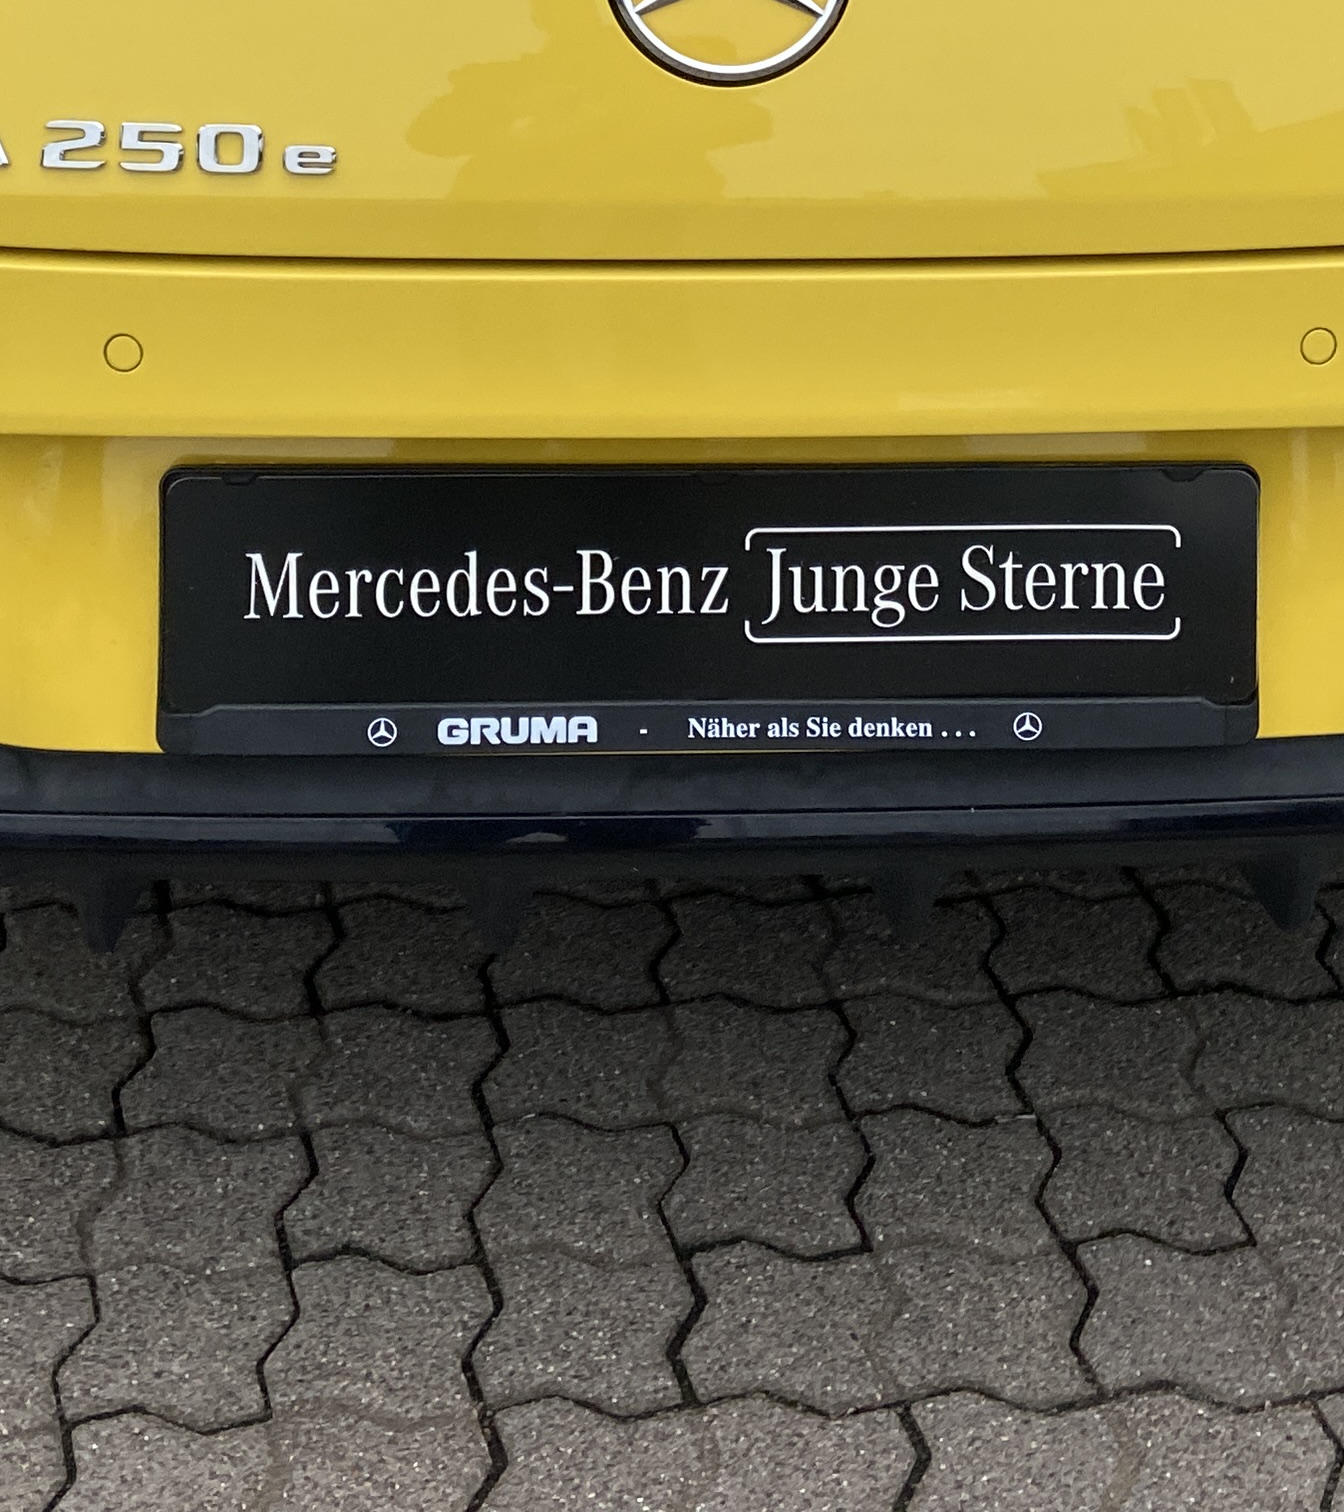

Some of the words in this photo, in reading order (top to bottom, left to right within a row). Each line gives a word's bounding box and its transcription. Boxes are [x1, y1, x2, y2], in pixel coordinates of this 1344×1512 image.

[243, 549, 729, 620] Mercedes-Benz
[761, 546, 939, 628] Junge
[960, 544, 1165, 612] Sterne
[437, 715, 598, 746] GRUMA
[687, 716, 761, 739] Näher
[767, 716, 800, 738] als
[806, 716, 842, 738] Sie
